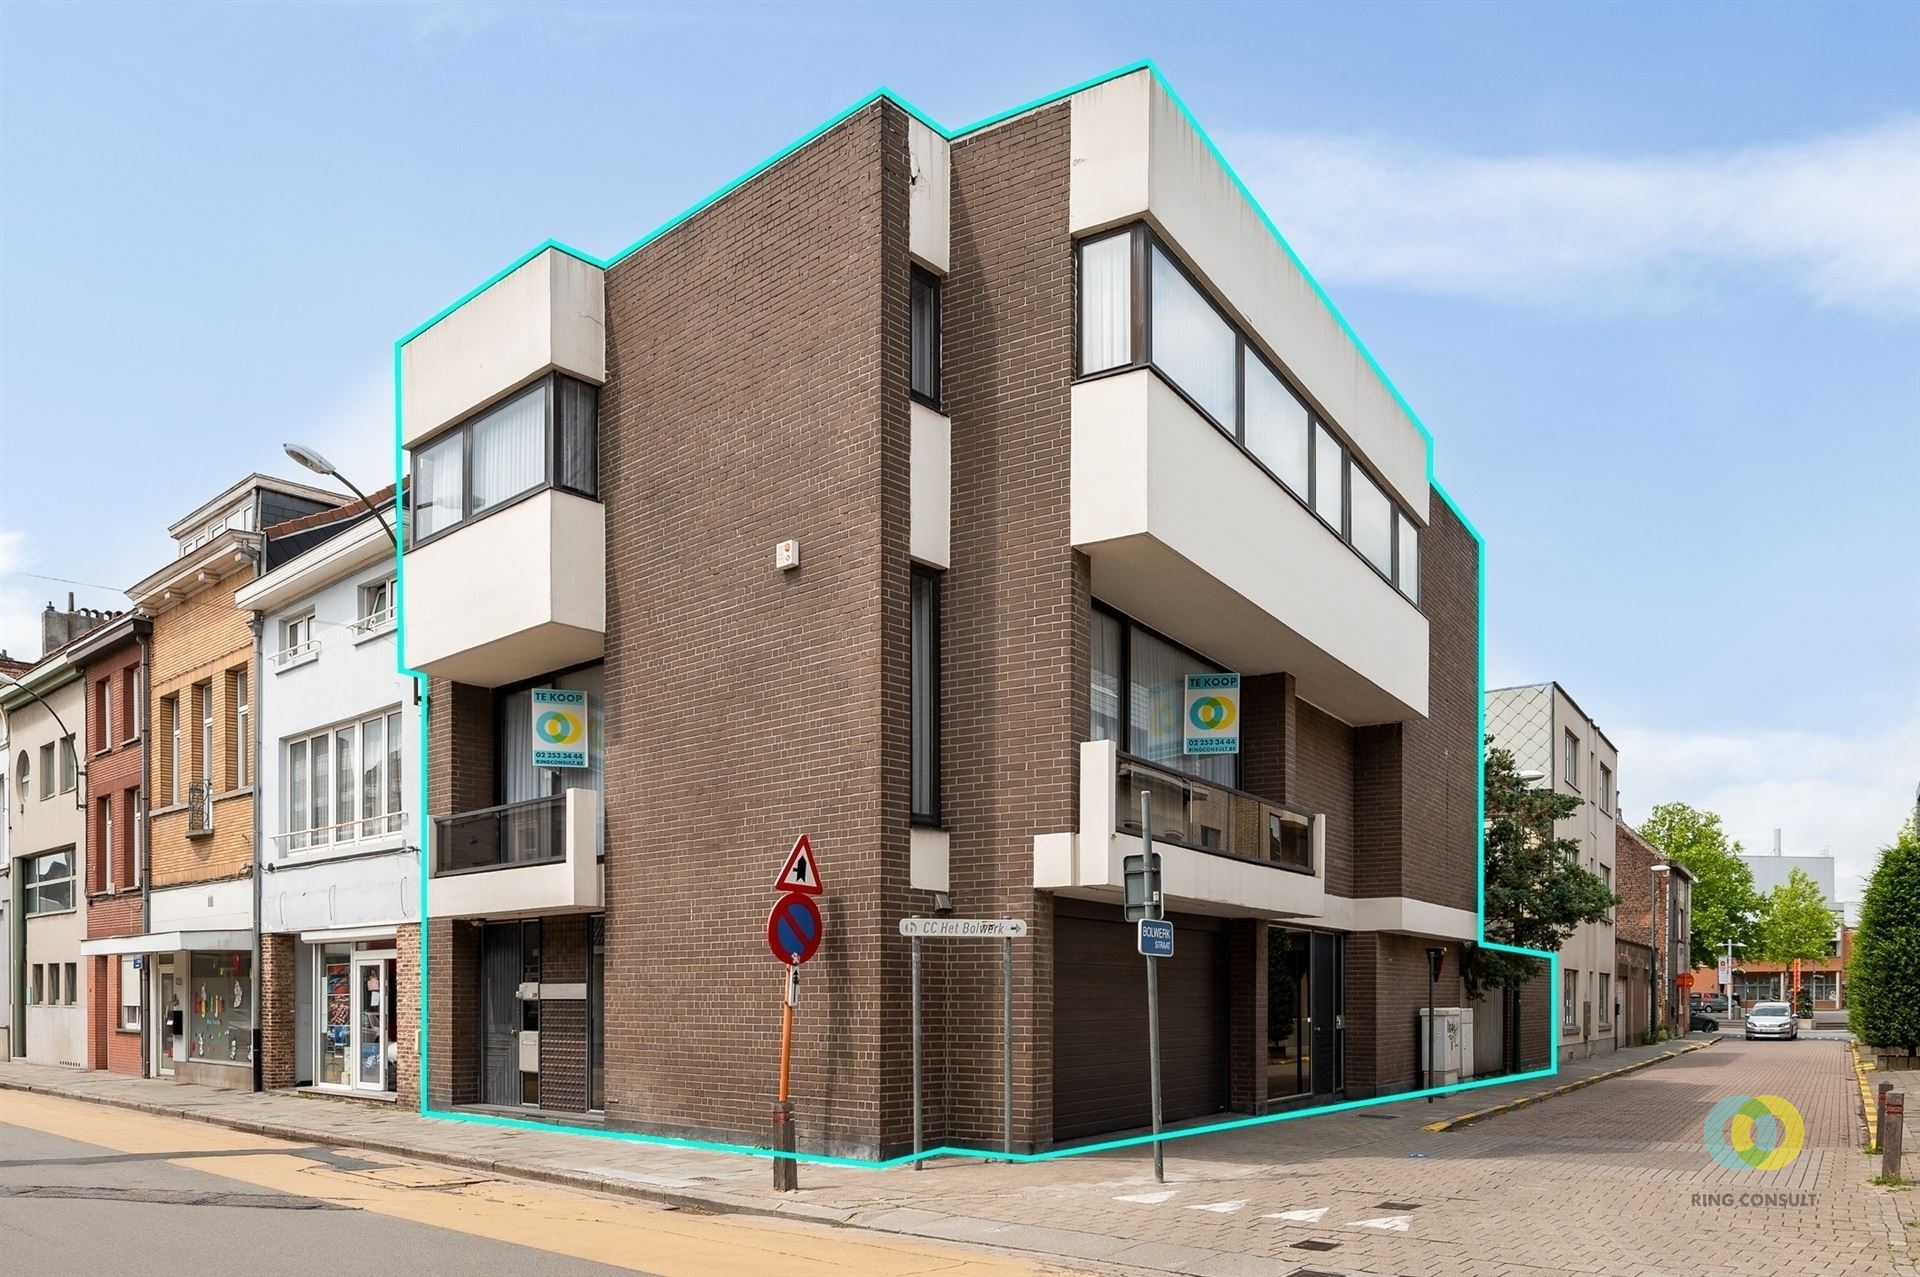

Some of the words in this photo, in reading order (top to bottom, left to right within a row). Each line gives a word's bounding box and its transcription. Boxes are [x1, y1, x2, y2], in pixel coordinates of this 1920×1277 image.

[1190, 678, 1200, 687] TE
[1204, 678, 1237, 686] KOOP
[535, 692, 546, 701] TE
[550, 694, 582, 702] KOOP
[923, 922, 938, 934] CC
[940, 922, 959, 934] Het
[962, 922, 1004, 934] Bolwerk
[1142, 926, 1170, 939] BOLWERK
[1154, 940, 1170, 950] STRAAT
